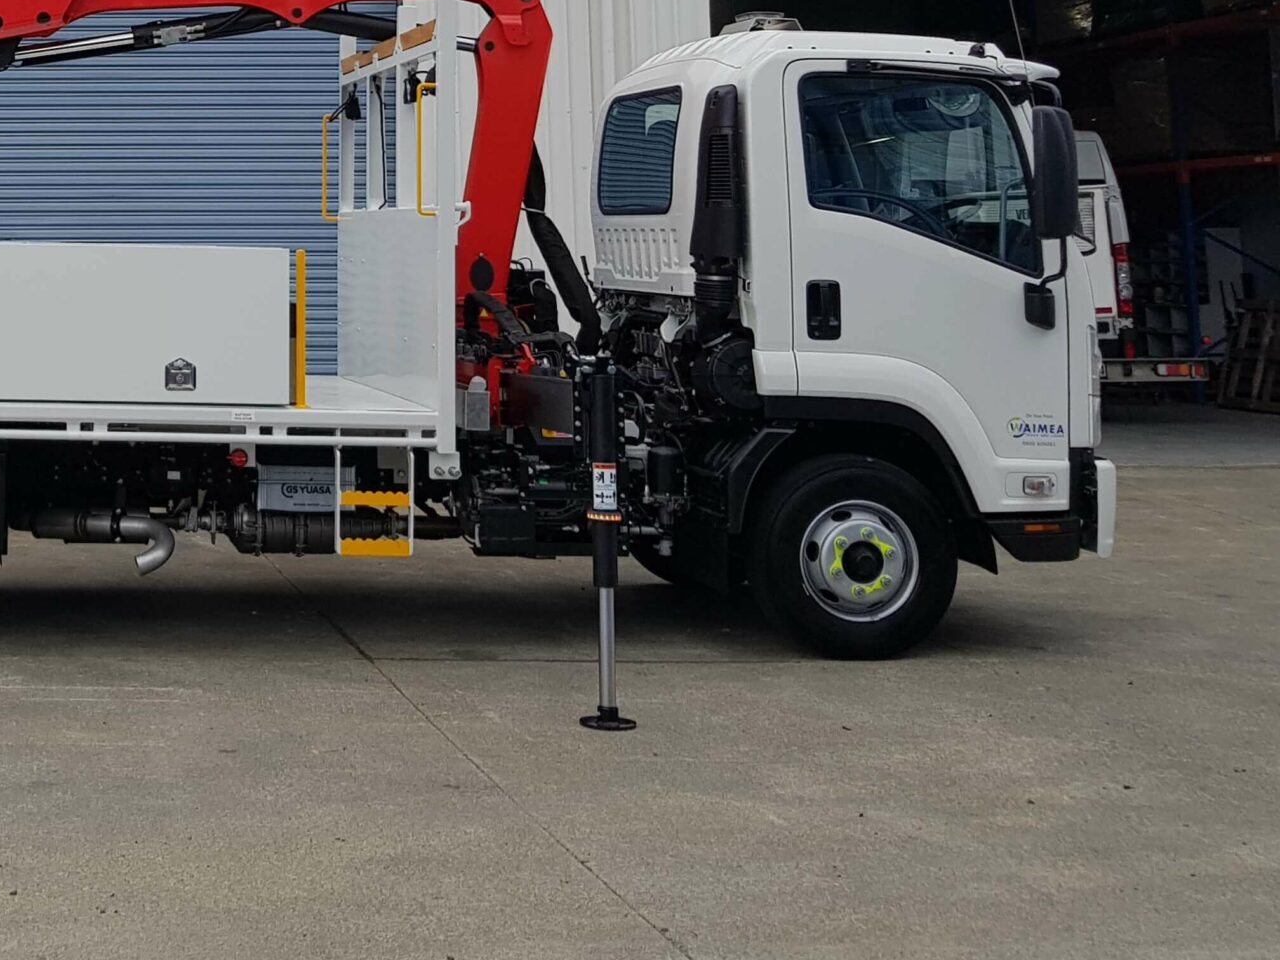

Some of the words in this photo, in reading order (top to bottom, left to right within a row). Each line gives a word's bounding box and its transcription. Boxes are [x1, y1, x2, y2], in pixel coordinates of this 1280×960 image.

[1009, 422, 1064, 434] WAIMEA
[284, 484, 298, 495] GS
[299, 485, 331, 494] YUASA
